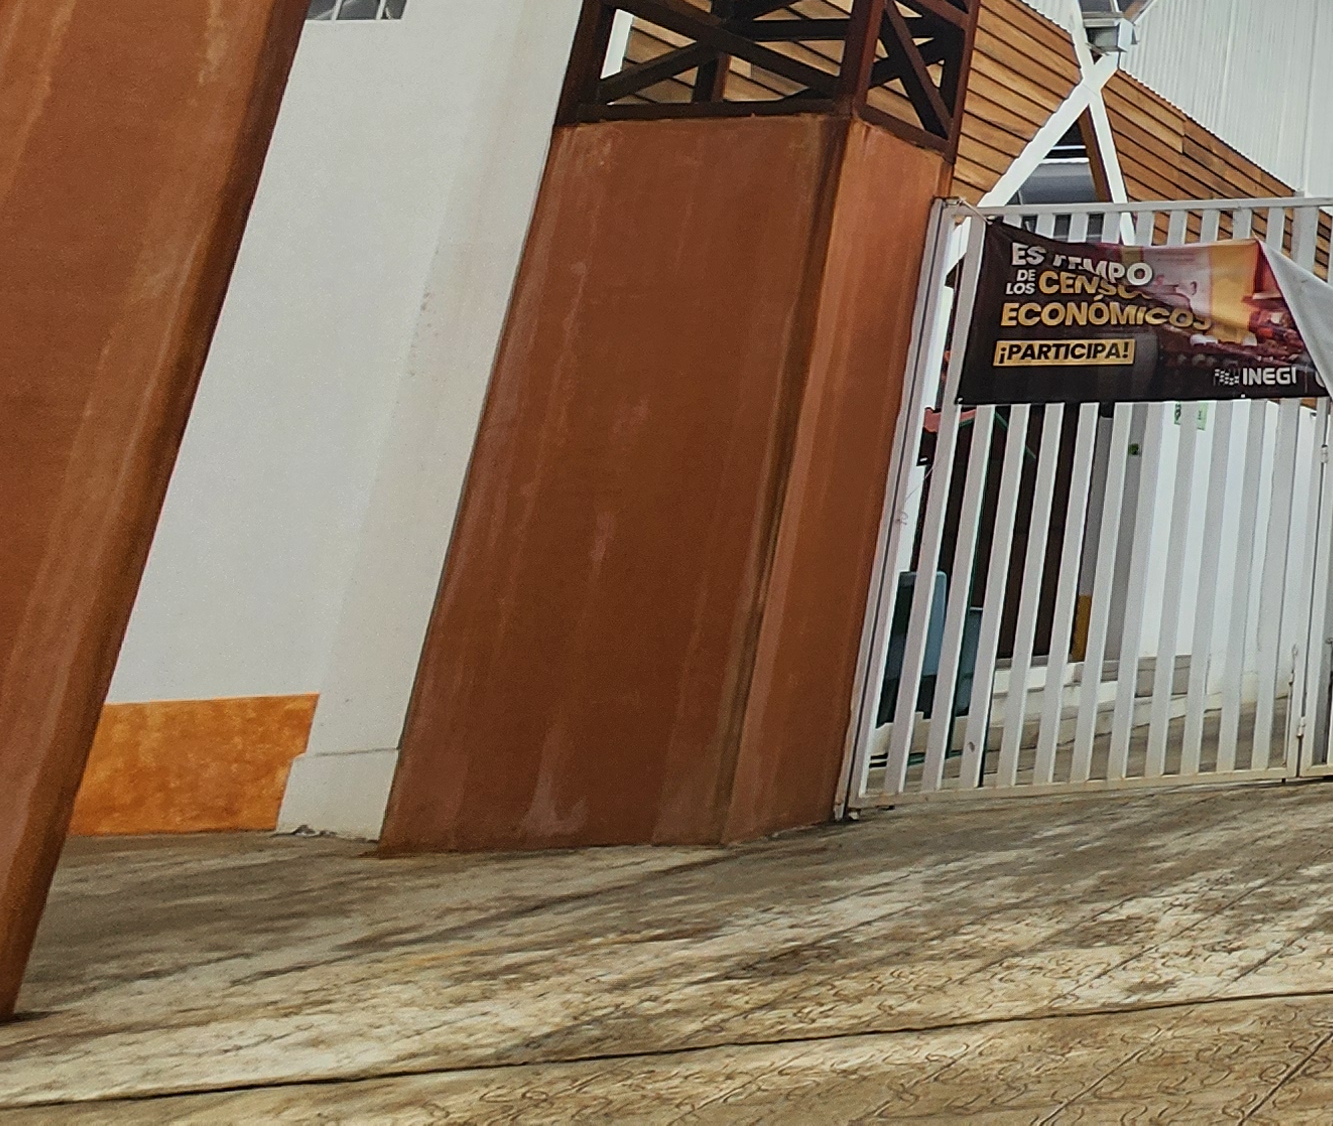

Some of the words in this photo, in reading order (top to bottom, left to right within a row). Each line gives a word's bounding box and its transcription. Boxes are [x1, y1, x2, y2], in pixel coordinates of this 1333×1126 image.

[1012, 242, 1047, 266] ES
[1016, 269, 1037, 282] DE
[1038, 270, 1152, 300] CENSO
[1006, 282, 1036, 295] LOS
[1000, 294, 1212, 331] ECONÓMICOS
[999, 341, 1130, 365] ¡PARTICIPA!
[1242, 366, 1297, 386] INEGI
